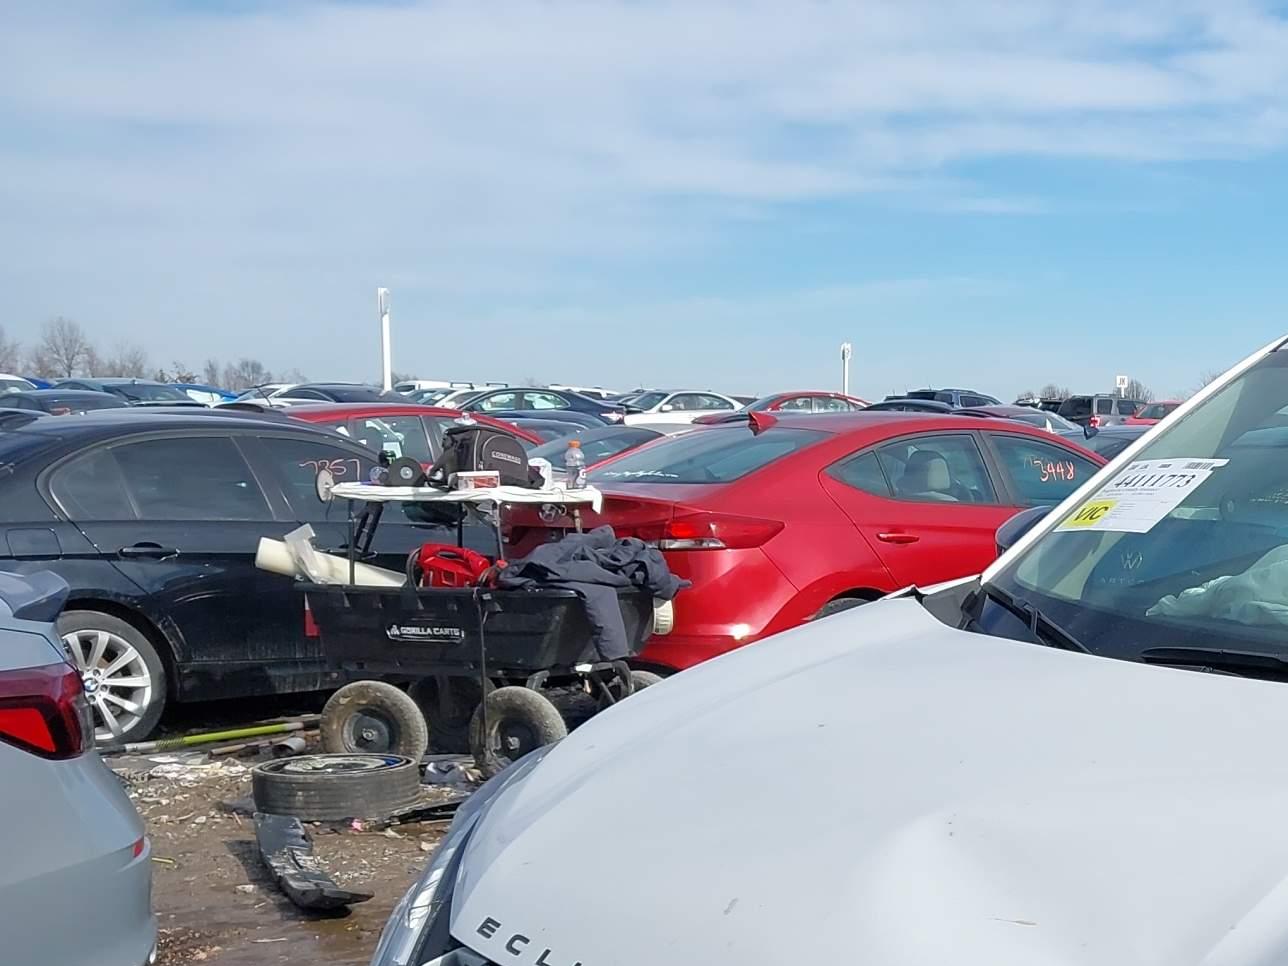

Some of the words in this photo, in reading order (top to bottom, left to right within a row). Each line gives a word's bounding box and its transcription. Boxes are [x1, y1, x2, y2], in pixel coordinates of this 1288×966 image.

[1033, 460, 1074, 481] 3448
[1114, 474, 1196, 489] 44111773
[1074, 506, 1109, 522] VIC
[400, 627, 433, 635] GORILLA
